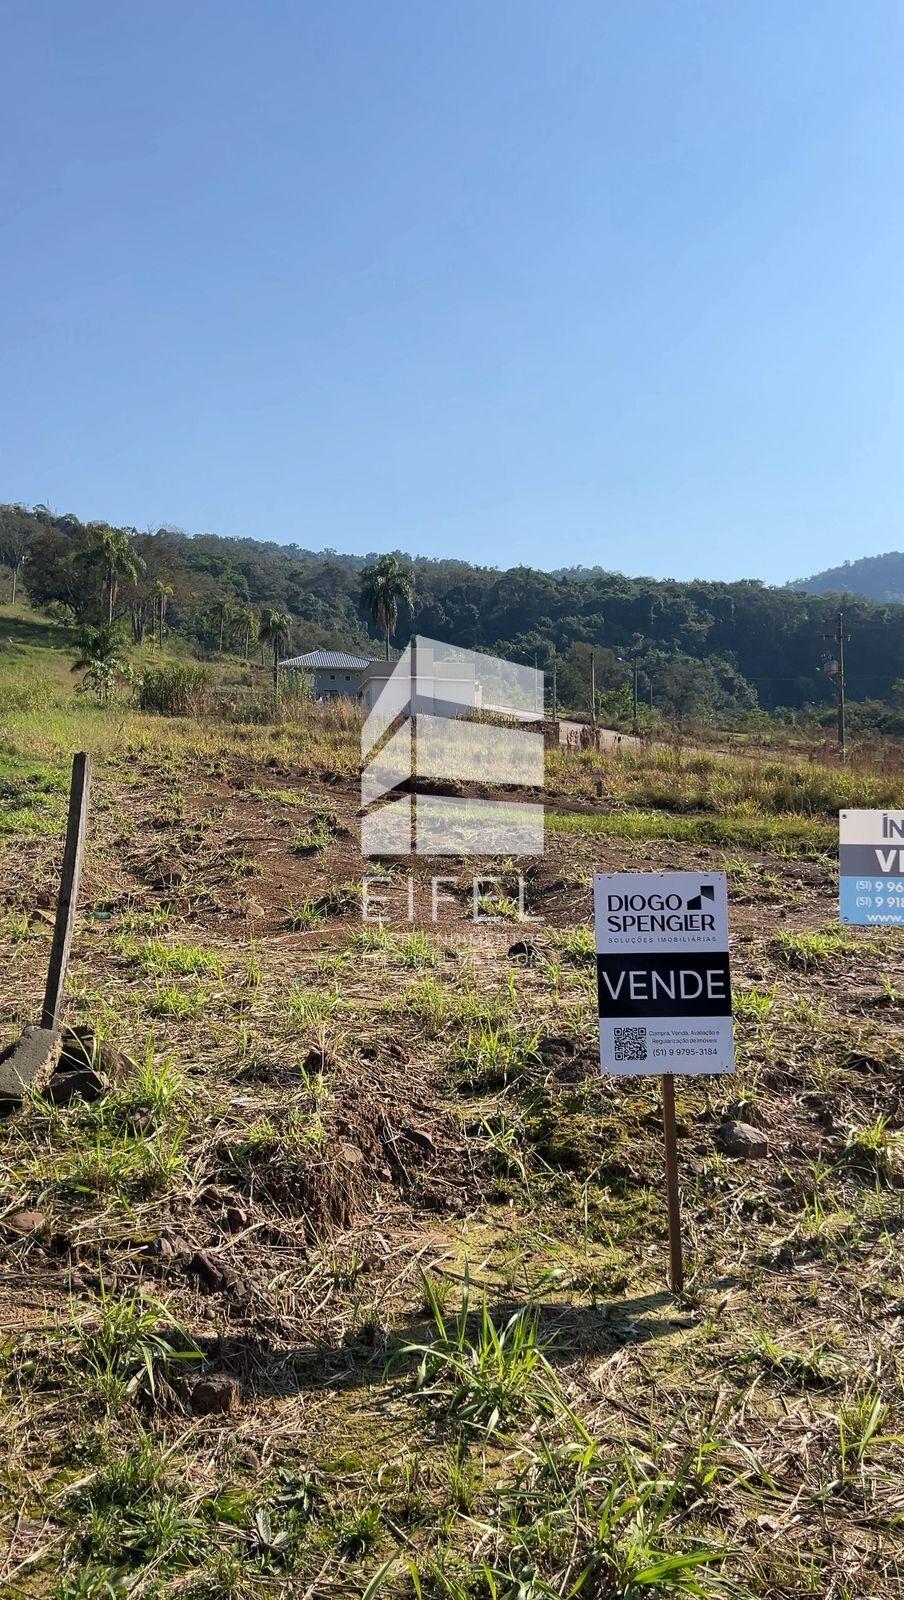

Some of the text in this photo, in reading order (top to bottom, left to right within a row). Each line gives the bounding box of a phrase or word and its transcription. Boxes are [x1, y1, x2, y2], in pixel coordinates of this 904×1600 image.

[856, 880, 872, 891] (51)
[875, 881, 884, 892] 9
[607, 894, 682, 911] DIOGO
[856, 896, 872, 907] (51)
[875, 897, 884, 907] 9
[607, 914, 715, 932] SPENGLER
[608, 936, 653, 944] SOLUÇÕES
[602, 970, 725, 1000] VENDE
[652, 1047, 718, 1057] (51) 9 9795-3184
